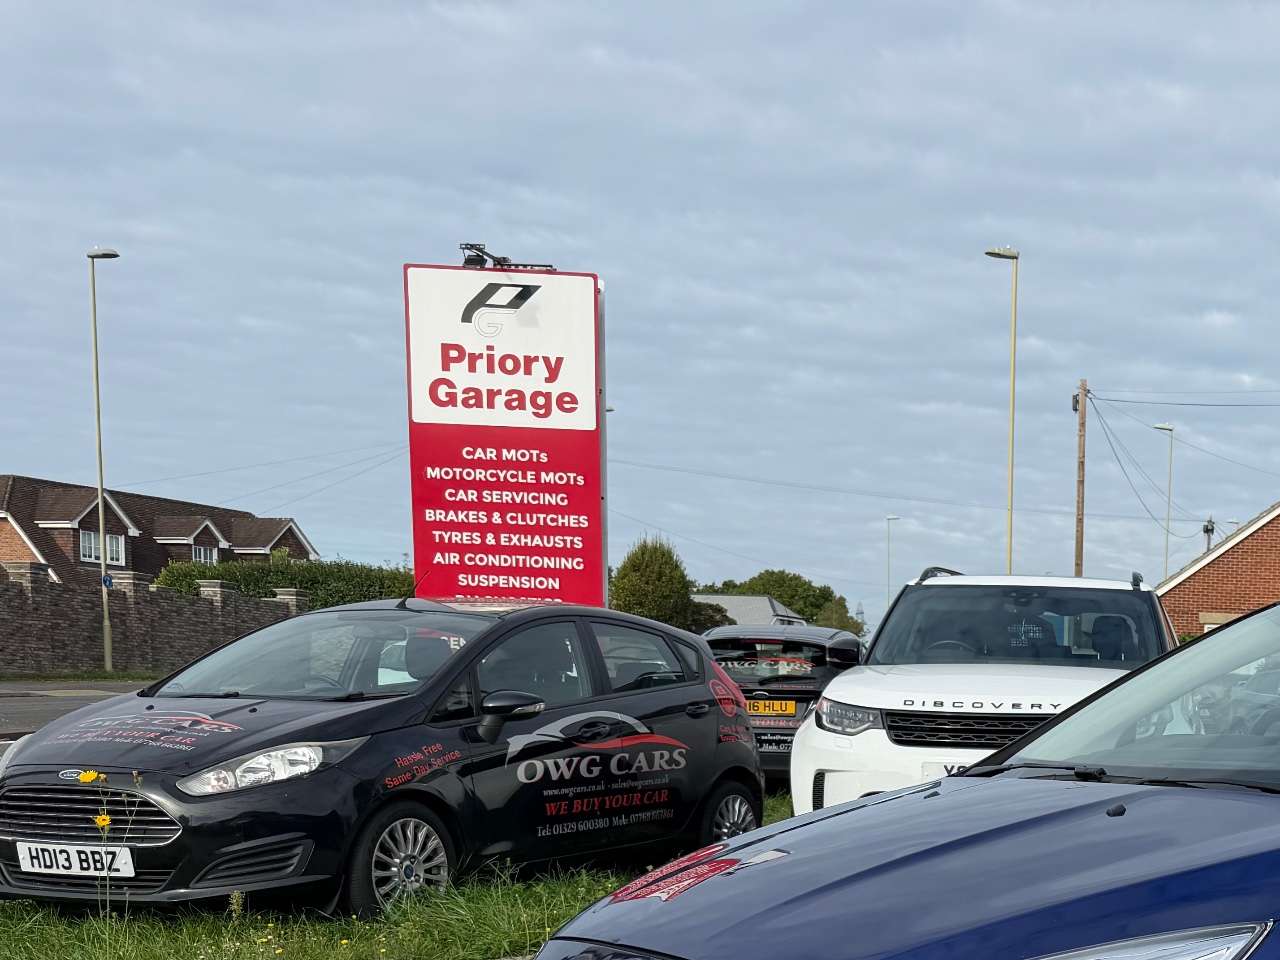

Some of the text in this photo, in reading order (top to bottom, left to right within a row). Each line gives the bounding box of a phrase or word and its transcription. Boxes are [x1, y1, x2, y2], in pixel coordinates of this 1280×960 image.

[440, 342, 564, 383] Priory
[428, 377, 579, 419] Garage
[462, 446, 548, 463] CAR MOTs
[426, 466, 585, 486] MOTORCYCLE MOTs
[445, 488, 569, 506] CAR SERVICING
[425, 509, 589, 528] BRAKES & CLUTCHES
[432, 530, 583, 549] TYRES & EXHAUSTS
[432, 552, 585, 570] AIR CONDITIONING
[457, 573, 560, 590] SUSPENSION
[748, 701, 788, 712] 16 HLU
[903, 699, 1062, 710] DISCOVERY
[394, 743, 443, 768] Hassle Free
[384, 750, 462, 788] Same Day Service
[516, 748, 687, 784] OWG CARS
[545, 789, 669, 816] WE BUY YOUR CAR
[536, 826, 552, 837] Tel:
[553, 822, 577, 835] 01329
[578, 817, 609, 831] 600380
[28, 847, 120, 872] HD13 BBZ
